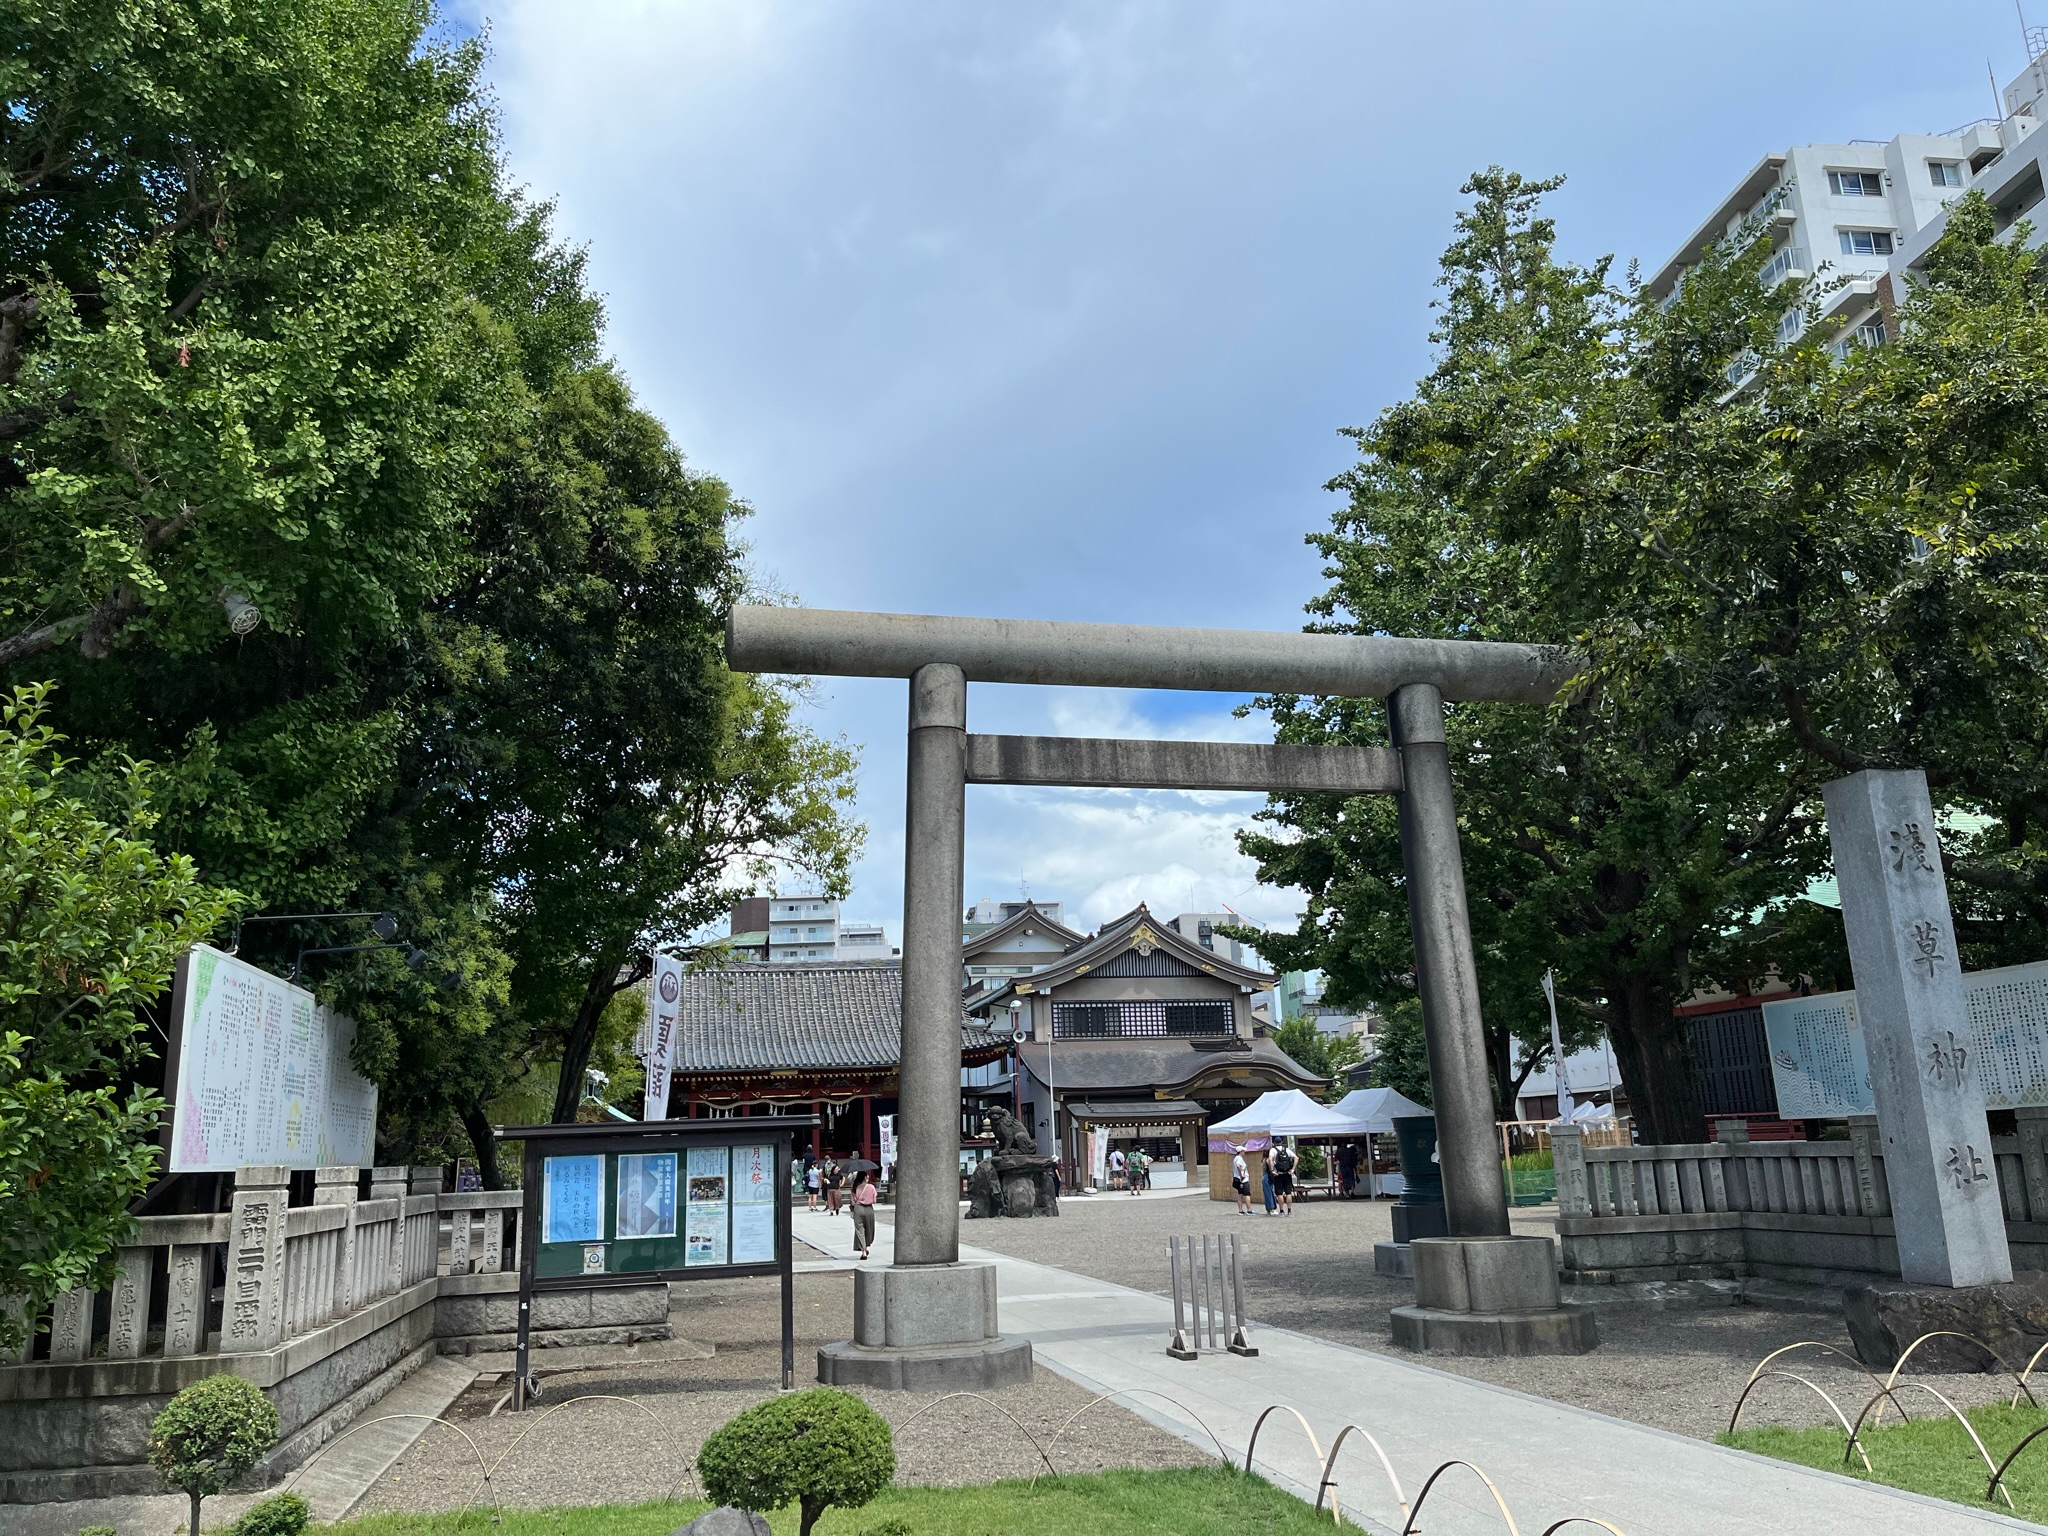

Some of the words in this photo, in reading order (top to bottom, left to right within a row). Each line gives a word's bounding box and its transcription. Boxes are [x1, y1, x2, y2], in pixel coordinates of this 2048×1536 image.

[750, 1147, 763, 1185] 月次祭
[231, 1202, 270, 1339] 雷門二丁目西部
